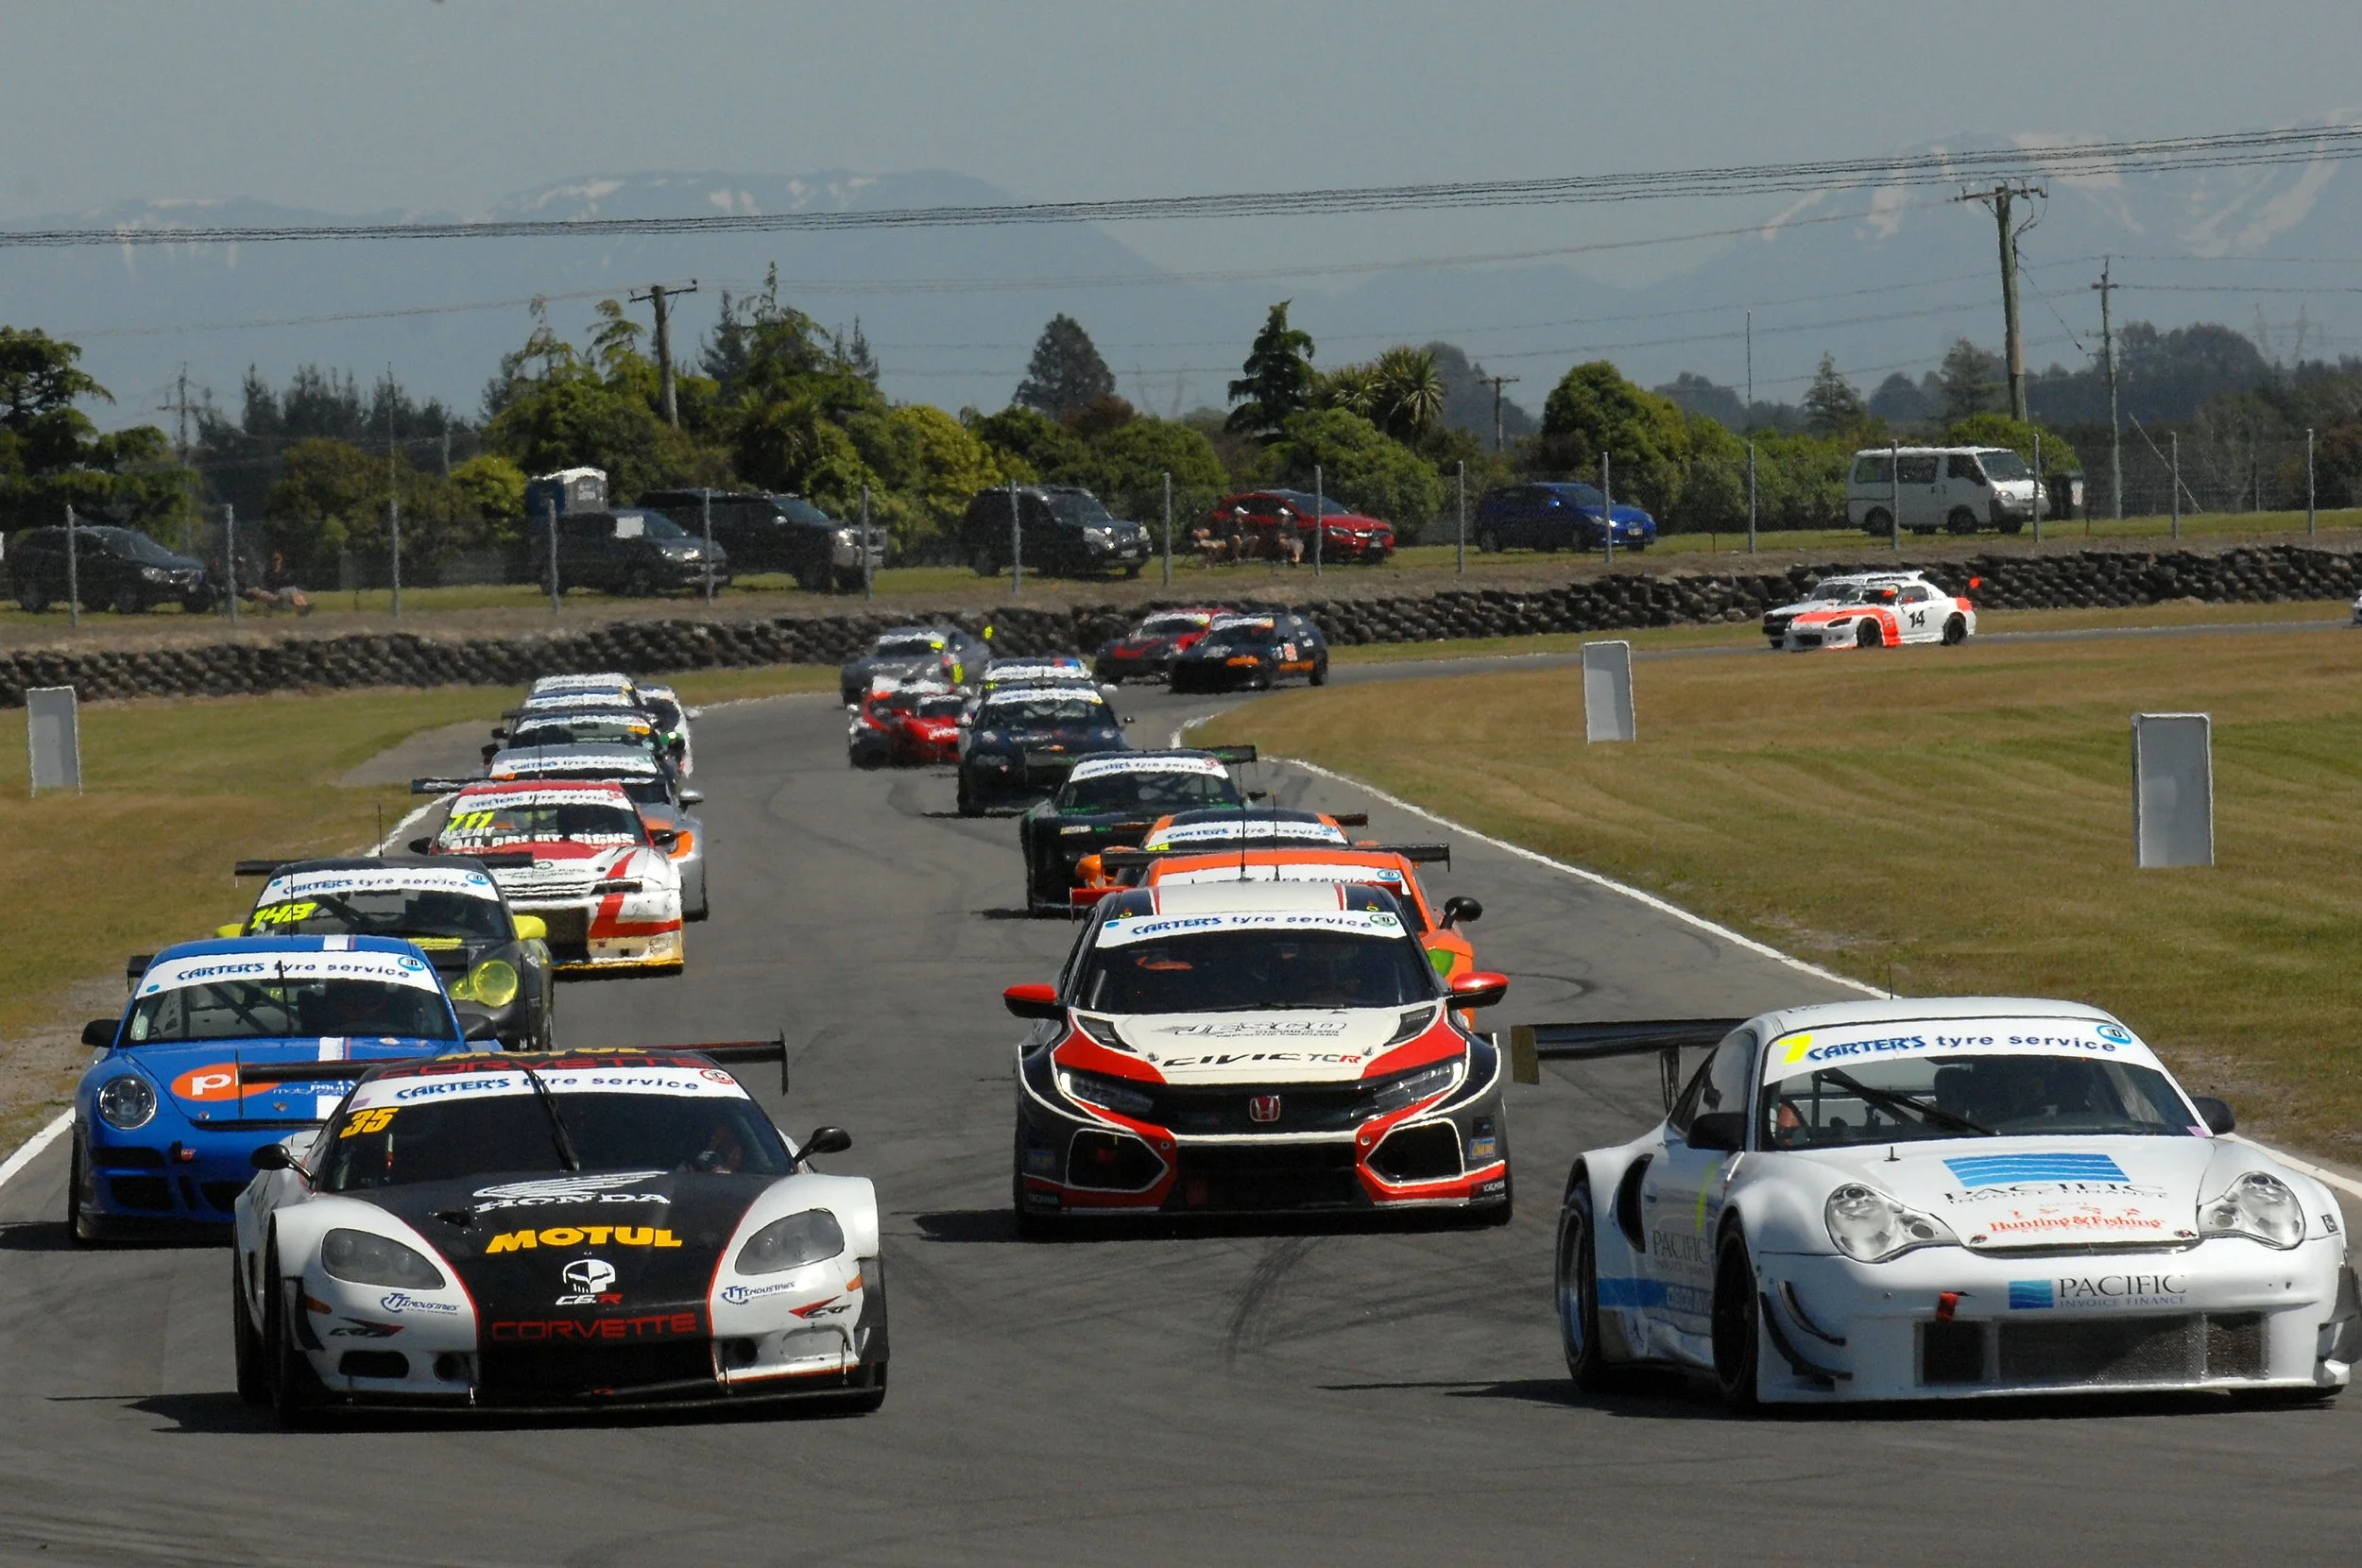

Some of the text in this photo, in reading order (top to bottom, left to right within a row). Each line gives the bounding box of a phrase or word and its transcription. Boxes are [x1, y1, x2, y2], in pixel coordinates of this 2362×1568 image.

[1908, 610, 1926, 628] 14
[1131, 914, 1372, 936] CARTER'S tyre service
[177, 963, 265, 980] CARTER'S
[327, 963, 411, 979] service
[1777, 1033, 1813, 1065] 7
[1807, 1034, 2117, 1061] CARTER'S tyre service
[1163, 1052, 1302, 1066] CIVIC
[397, 1078, 511, 1099] CARTER'S
[592, 1076, 699, 1090] service
[339, 1107, 400, 1138] 35
[473, 1193, 671, 1213] HONDA
[485, 1226, 683, 1253] MOTUL
[2060, 1275, 2186, 1297] PACIFIC
[2060, 1295, 2186, 1308] INVOICE FINANCE
[491, 1312, 697, 1340] CORVETTE
